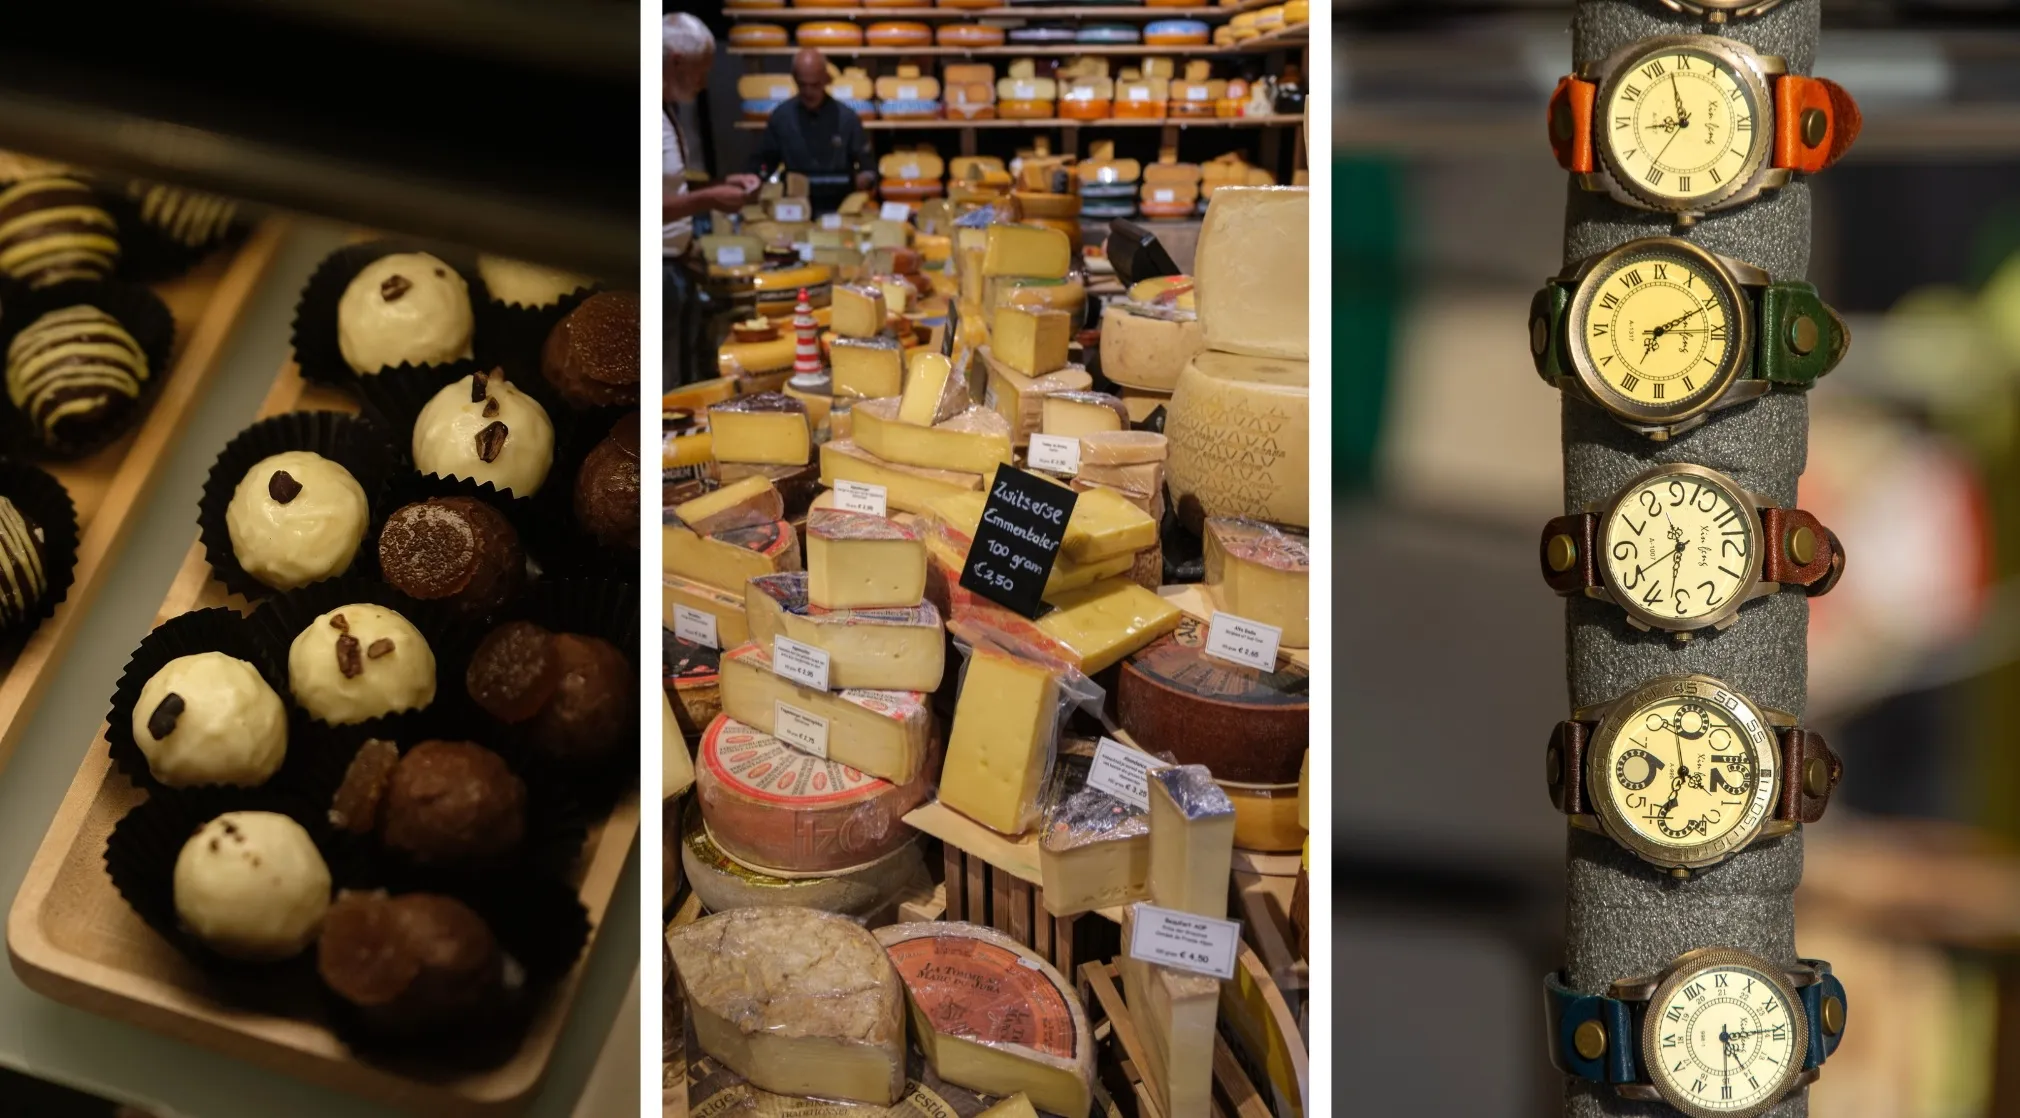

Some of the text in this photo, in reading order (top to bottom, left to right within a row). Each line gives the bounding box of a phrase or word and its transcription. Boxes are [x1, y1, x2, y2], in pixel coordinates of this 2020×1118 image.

[1642, 60, 1665, 80] VIII
[1677, 54, 1691, 70] IX
[1707, 61, 1722, 78] X
[1621, 84, 1642, 102] VII
[1615, 116, 1631, 130] VI
[1737, 113, 1752, 131] XII
[1623, 148, 1637, 160] V
[1645, 166, 1664, 186] IIII
[1679, 176, 1691, 192] III
[1709, 168, 1722, 184] II
[1619, 269, 1643, 289] VIII
[1653, 264, 1668, 279] IX
[1683, 271, 1698, 288] X
[1599, 292, 1619, 310] VII
[1702, 293, 1720, 311] XI
[1593, 323, 1609, 337] VI
[1711, 324, 1726, 341] XII
[1600, 355, 1614, 367] V
[1620, 372, 1640, 392] IIII
[1653, 383, 1665, 398] III
[1682, 376, 1695, 392] II
[994, 481, 1063, 525] Zwitserse
[1669, 481, 1685, 507] 9
[1689, 484, 1718, 513] 10
[984, 508, 1059, 551] Emmentaler
[1621, 514, 1646, 536] 7
[1613, 540, 1637, 560] 6
[1721, 531, 1746, 557] 12
[988, 540, 1043, 575] 100 gram
[1624, 564, 1645, 590] 5
[1643, 580, 1664, 606] 4
[1675, 588, 1690, 614] 3
[1697, 580, 1722, 605] 2
[1673, 682, 1698, 694] 45
[1714, 690, 1739, 711] 50
[1708, 723, 1732, 751] 10
[1747, 719, 1766, 744] 55
[1616, 749, 1665, 791] 6
[1710, 751, 1751, 795] 12
[1626, 793, 1646, 809] 5
[1714, 974, 1728, 988] IX
[1742, 978, 1755, 994] X
[1683, 982, 1706, 1001] VIII
[1739, 992, 1750, 1001] 22
[1666, 1004, 1685, 1023] VII
[1762, 996, 1779, 1014] XI
[1663, 1034, 1676, 1048] VI
[1772, 1023, 1786, 1042] XII
[1673, 1061, 1685, 1073] V
[1748, 1076, 1760, 1090] II
[905, 1081, 947, 1118] Prestig
